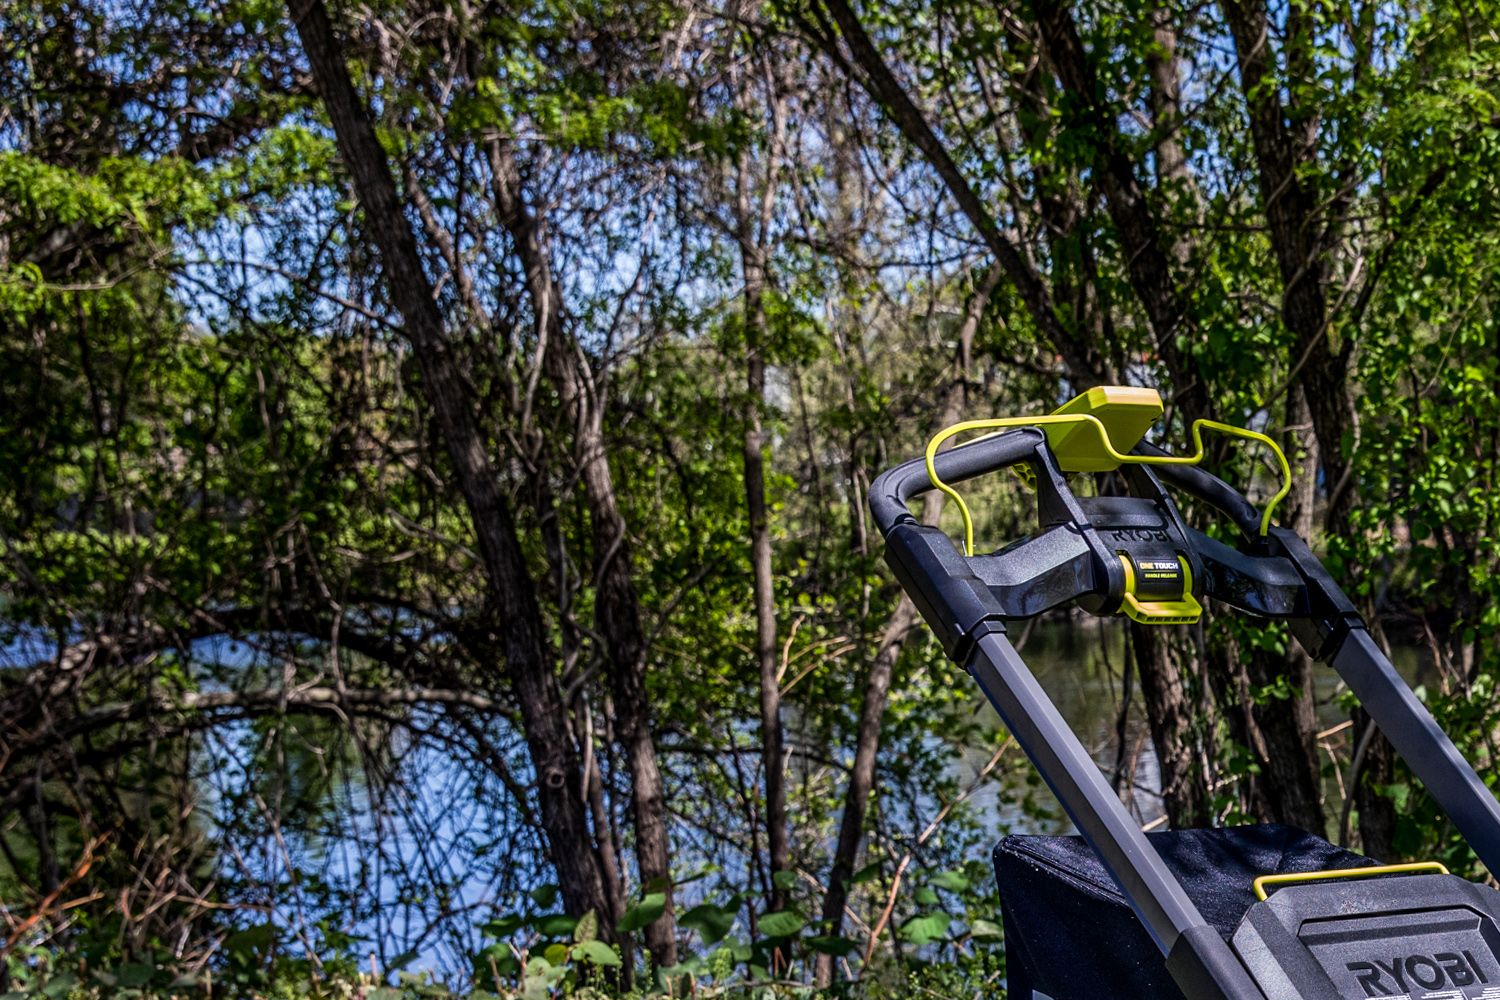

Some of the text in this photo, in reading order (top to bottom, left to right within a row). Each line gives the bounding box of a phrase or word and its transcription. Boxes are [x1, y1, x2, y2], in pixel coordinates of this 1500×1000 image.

[1139, 562, 1178, 570] ONE TOUCH
[1345, 950, 1488, 997] RYOBI
